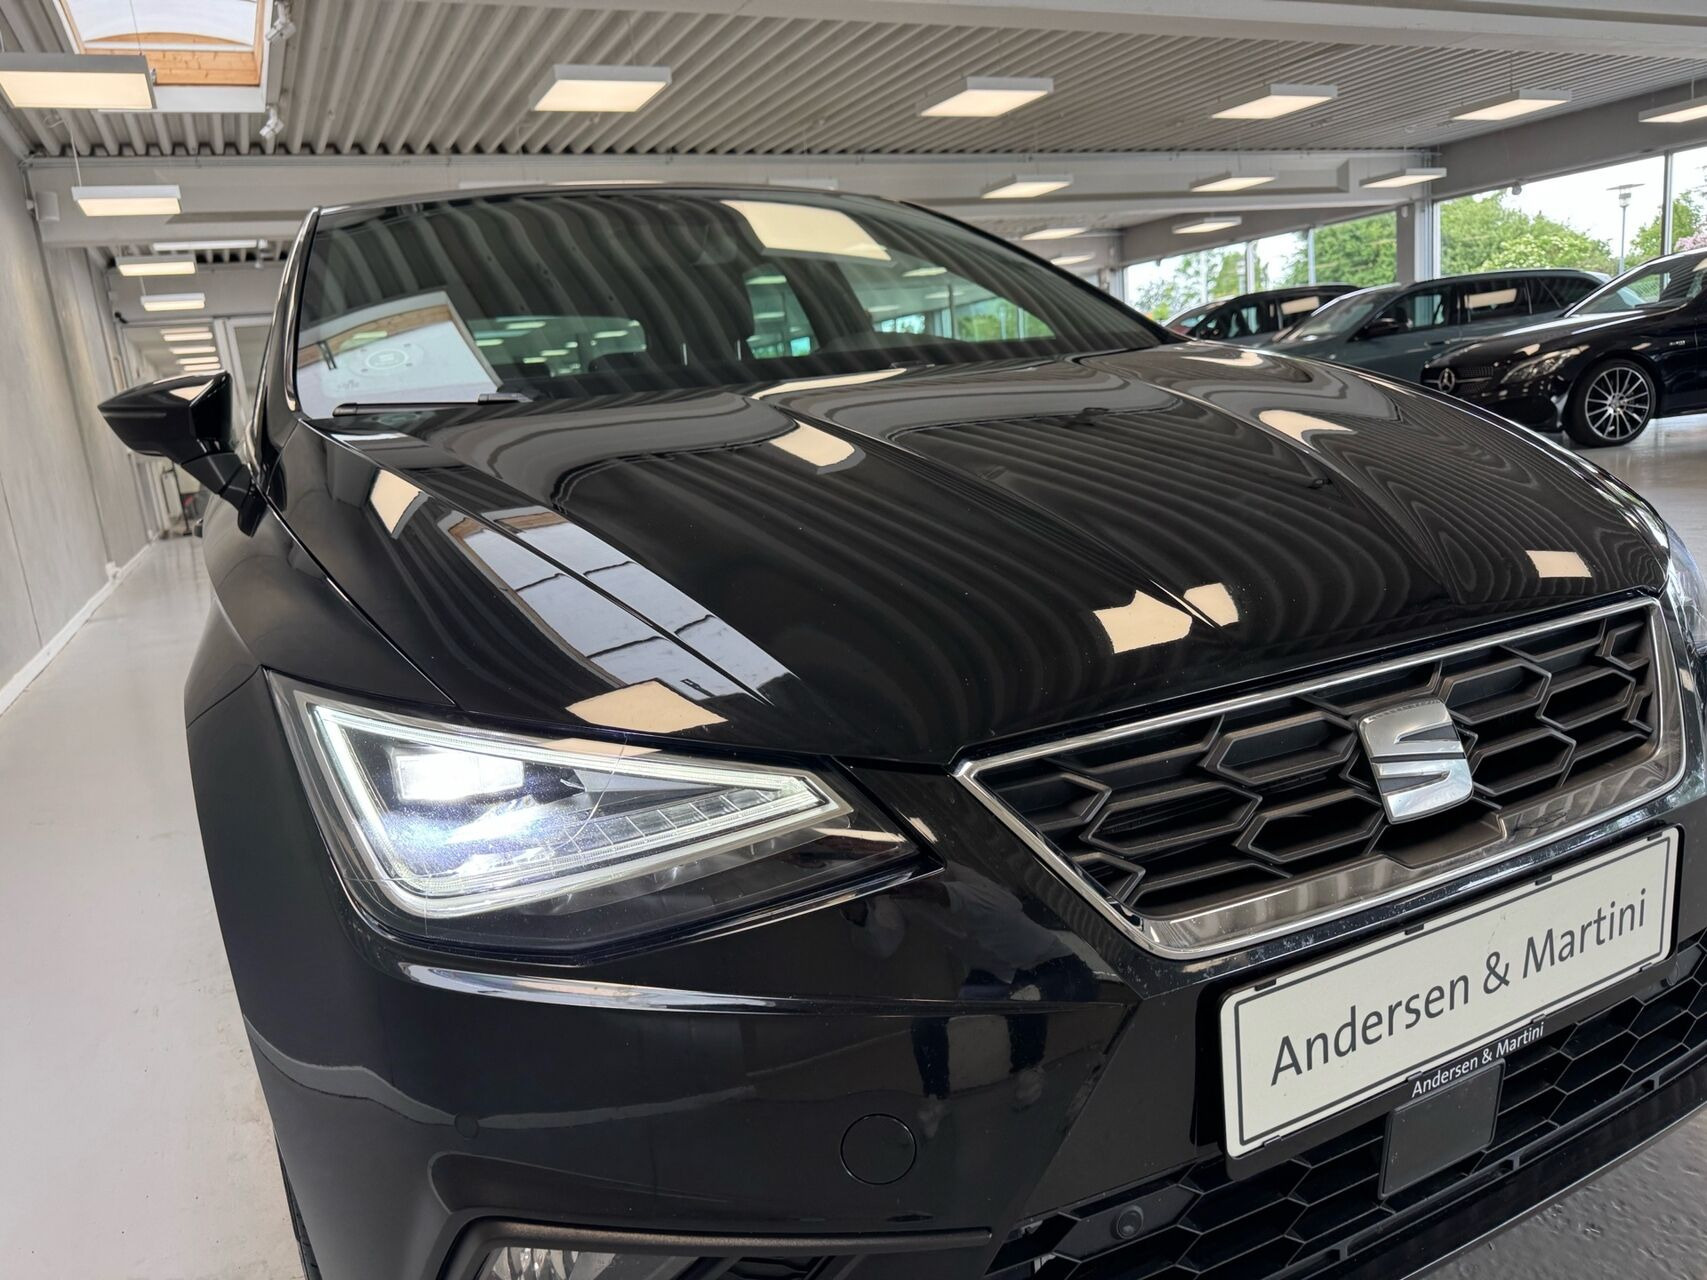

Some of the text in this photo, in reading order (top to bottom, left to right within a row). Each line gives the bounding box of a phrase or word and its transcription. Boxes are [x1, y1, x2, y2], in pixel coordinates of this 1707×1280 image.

[1270, 887, 1647, 1087] Andersen & Martini
[1411, 1021, 1545, 1098] Andersen & Martini
